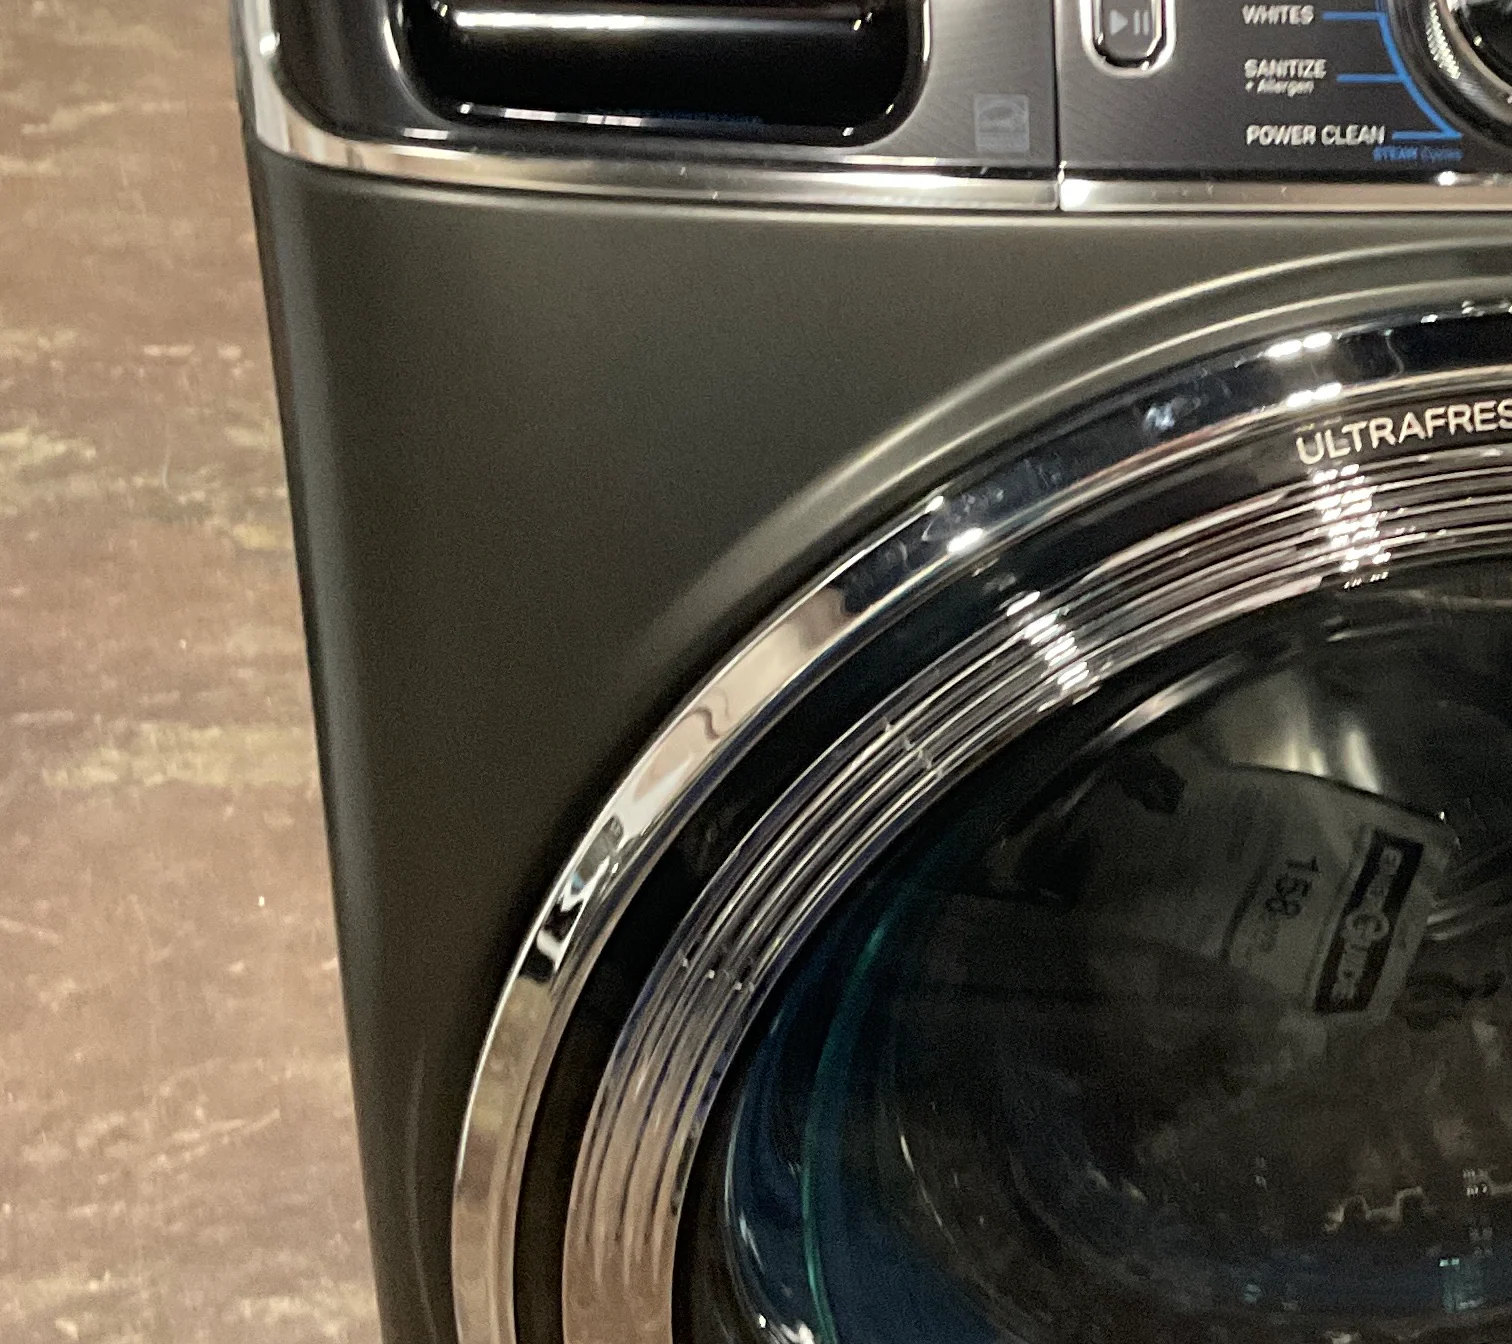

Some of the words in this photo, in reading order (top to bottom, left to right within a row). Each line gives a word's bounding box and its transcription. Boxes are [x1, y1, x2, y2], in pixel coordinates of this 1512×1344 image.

[1241, 5, 1315, 25] WHITES
[1244, 58, 1328, 80] SANITIZE
[1246, 125, 1317, 146] POWER
[1321, 125, 1386, 145] CLEAN
